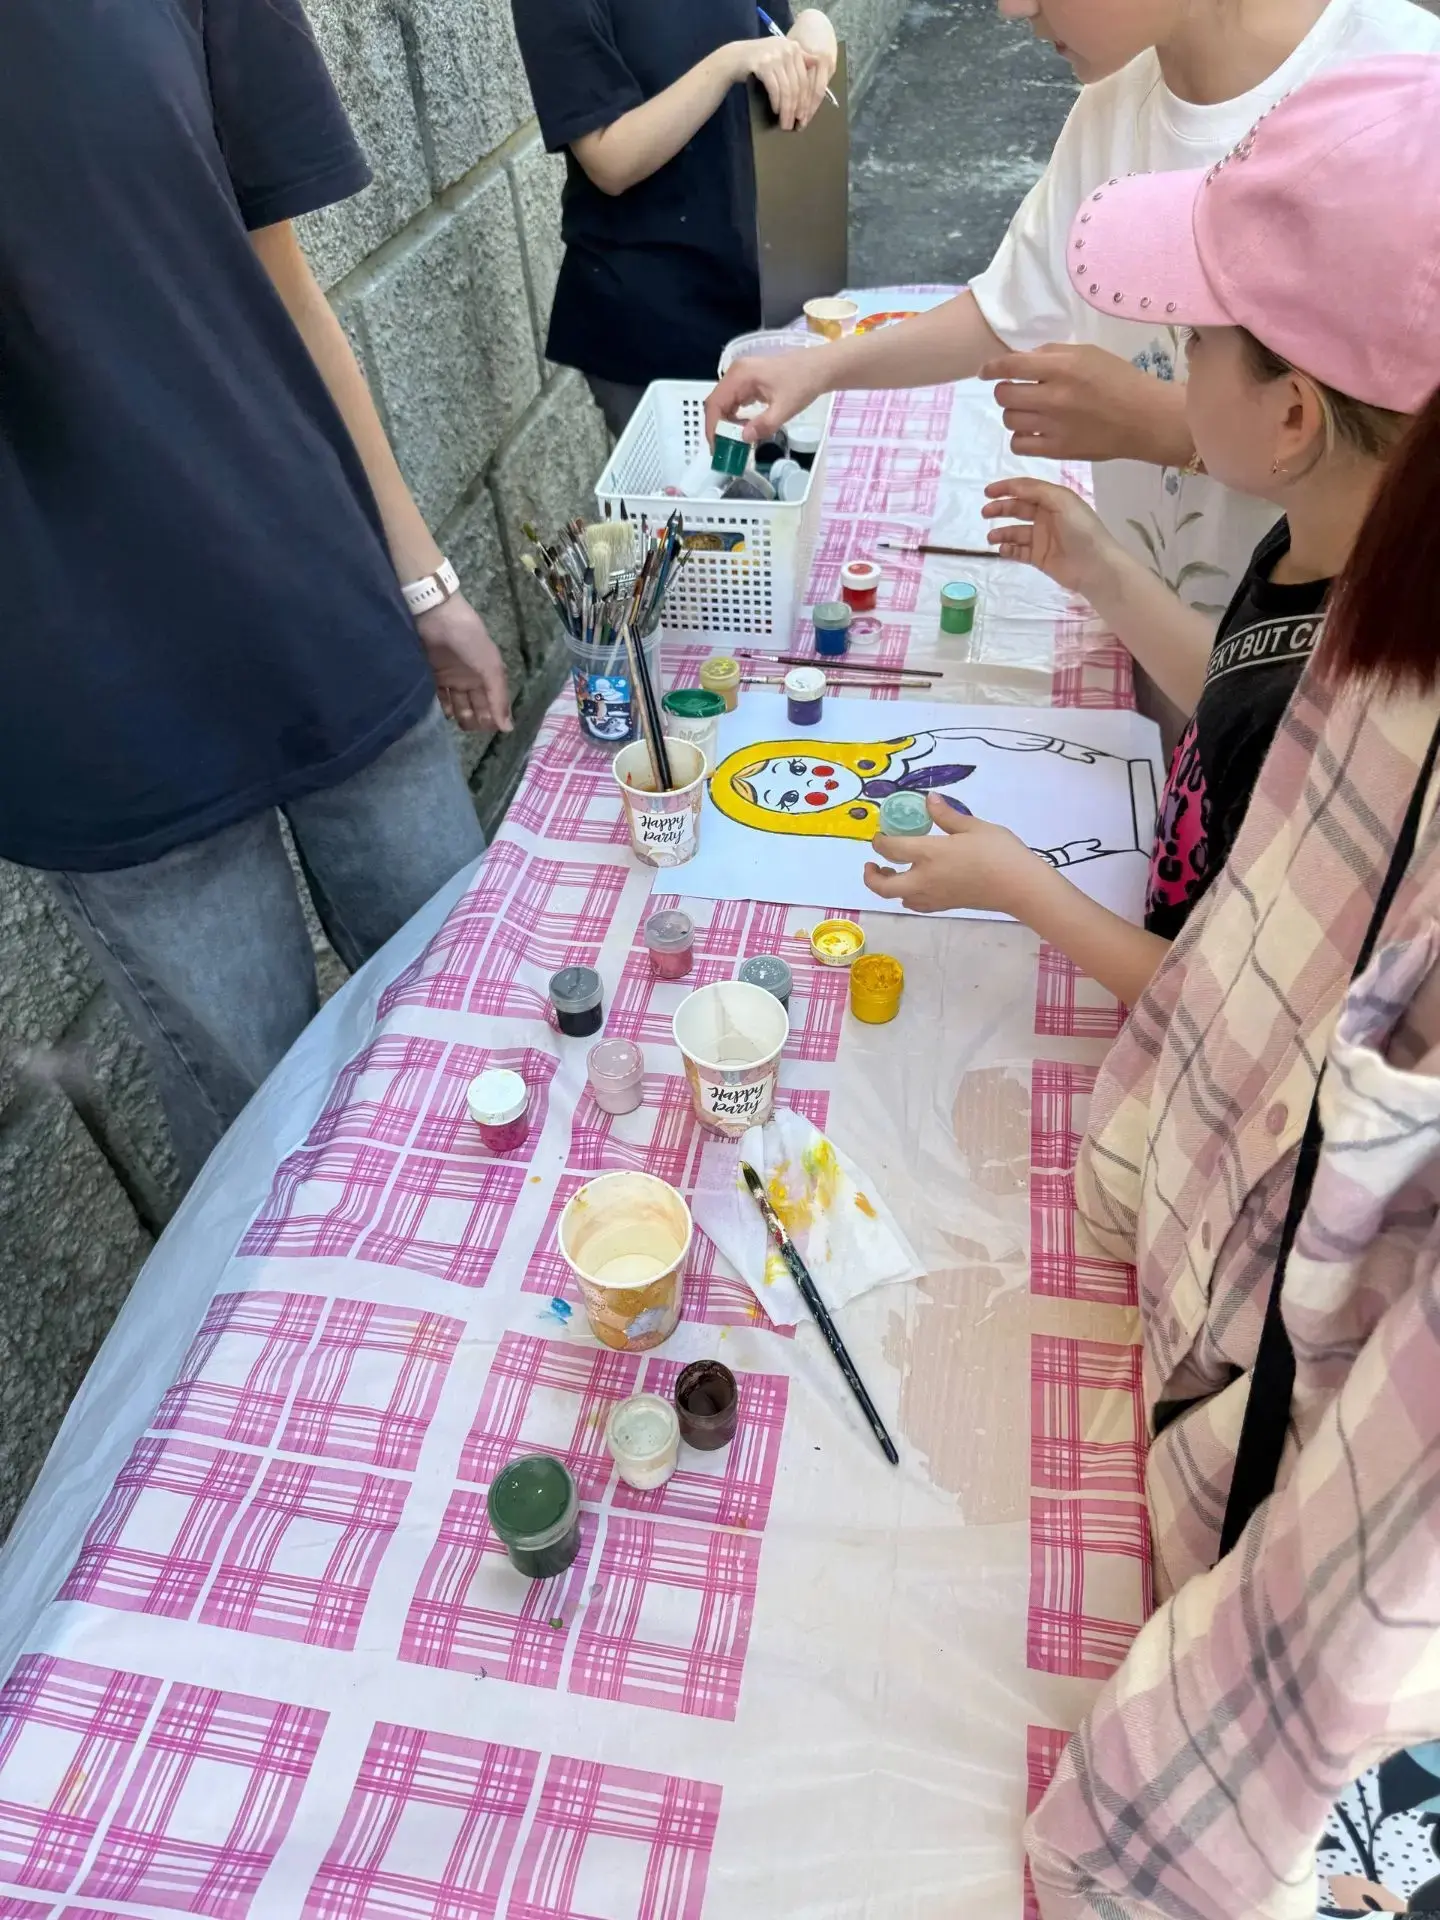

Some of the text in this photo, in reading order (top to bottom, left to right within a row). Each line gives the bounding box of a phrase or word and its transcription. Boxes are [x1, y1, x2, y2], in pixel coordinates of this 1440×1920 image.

[1238, 626, 1288, 660] BUT
[638, 813, 687, 832] Happy
[707, 1081, 767, 1104] Happy
